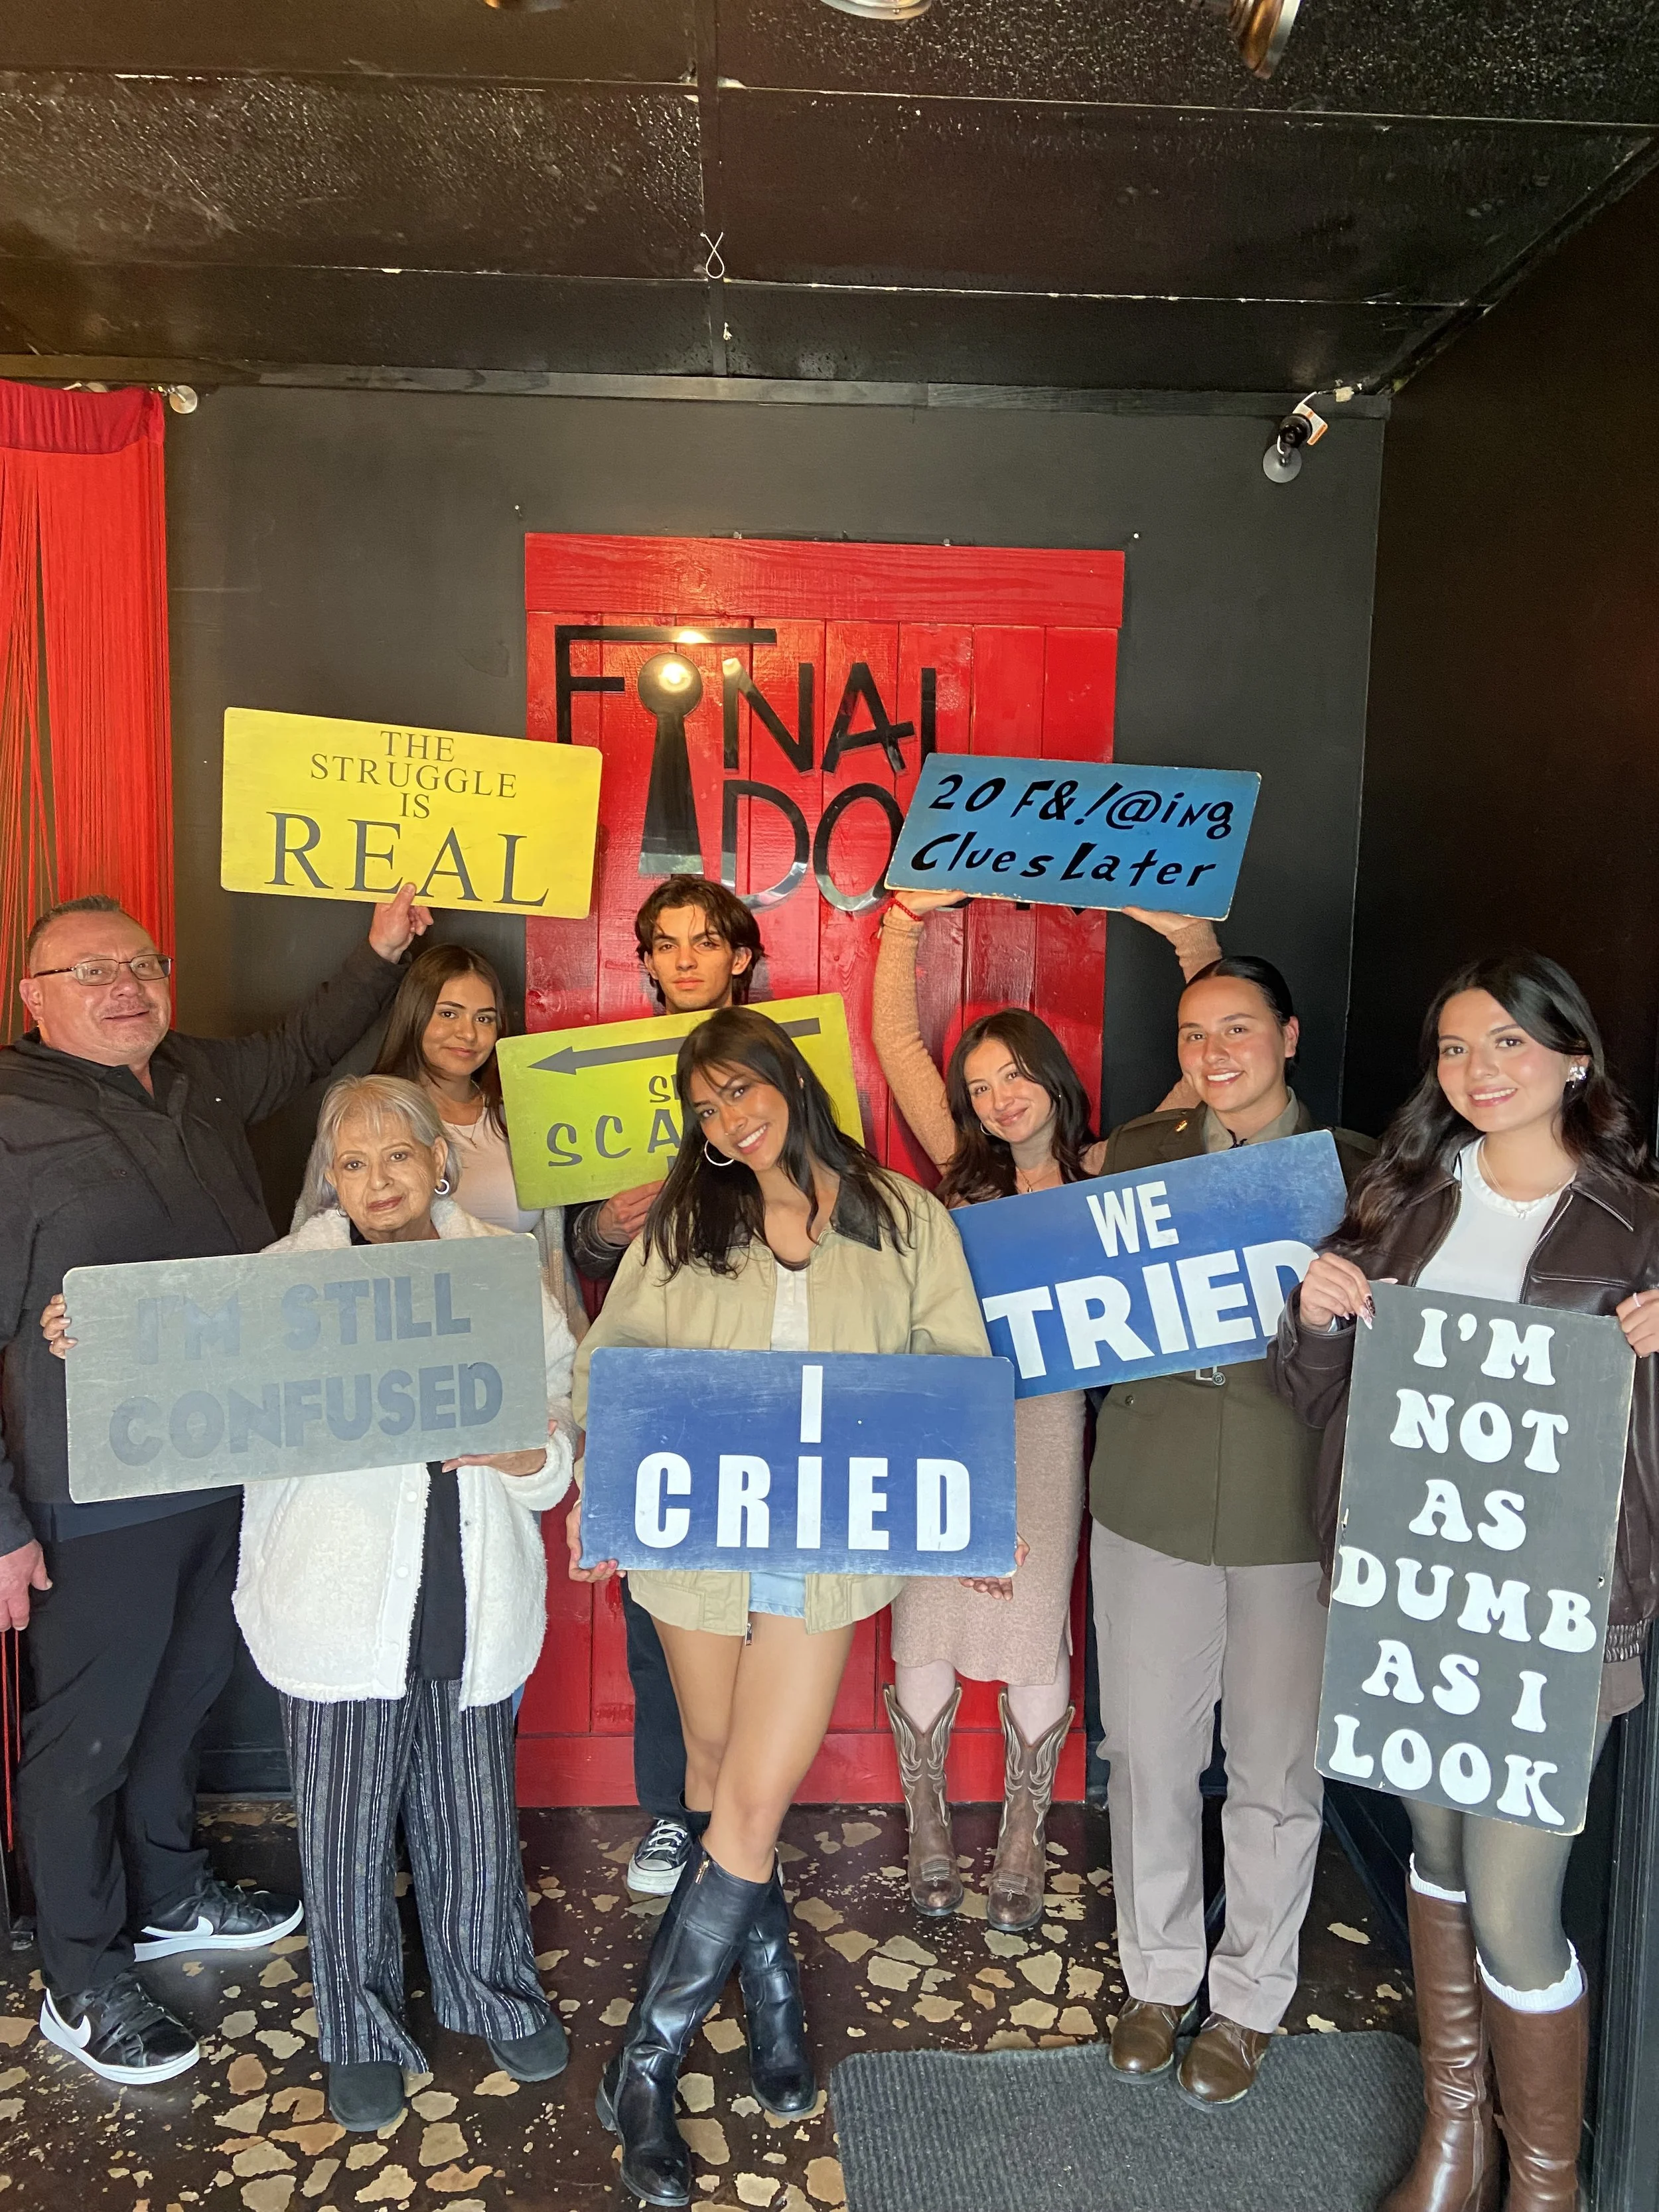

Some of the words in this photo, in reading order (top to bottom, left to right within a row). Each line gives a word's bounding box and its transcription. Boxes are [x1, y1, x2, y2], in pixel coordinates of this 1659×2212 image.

[311, 753, 517, 798] STRUGGLE
[380, 730, 455, 763] THE
[399, 793, 430, 818] IS
[928, 774, 1007, 812] 20
[264, 812, 549, 907] REAL
[911, 832, 1055, 877] Clues
[1060, 842, 1216, 887] Later
[1086, 1181, 1180, 1258] WE
[137, 1290, 240, 1364] I'M
[281, 1273, 472, 1351] STILL
[982, 1240, 1320, 1379] TRIED
[1413, 1308, 1556, 1386] I'M
[108, 1362, 503, 1467] CONFUSED
[800, 1364, 824, 1443] I
[1390, 1388, 1569, 1474] NOT
[634, 1451, 971, 1552] CRIED
[1408, 1479, 1527, 1551] AS
[1332, 1546, 1597, 1653] DUMB
[1361, 1639, 1481, 1716] AS
[1511, 1670, 1548, 1733] I
[1329, 1714, 1565, 1826] LOOK
